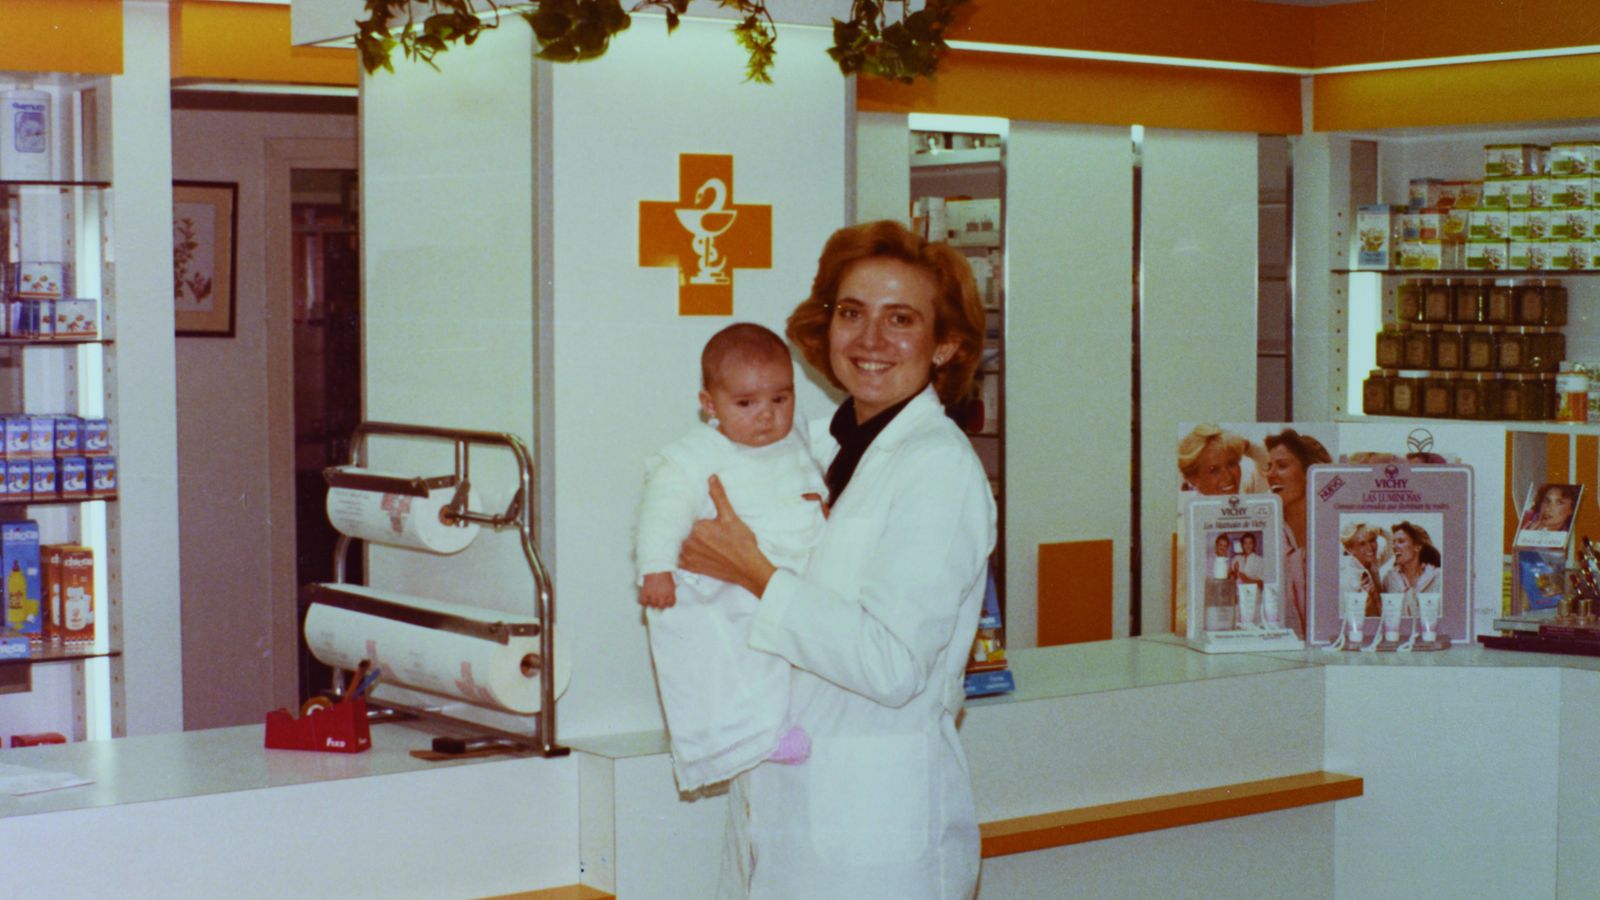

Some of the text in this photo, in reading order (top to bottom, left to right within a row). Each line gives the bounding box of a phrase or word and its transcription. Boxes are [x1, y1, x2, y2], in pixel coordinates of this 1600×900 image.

[1318, 475, 1346, 502] NUEVO
[1375, 479, 1408, 489] VICHY
[1362, 493, 1377, 502] LAS
[1221, 507, 1247, 516] VICHY
[3, 527, 39, 541] chicco
[64, 557, 93, 567] chicco
